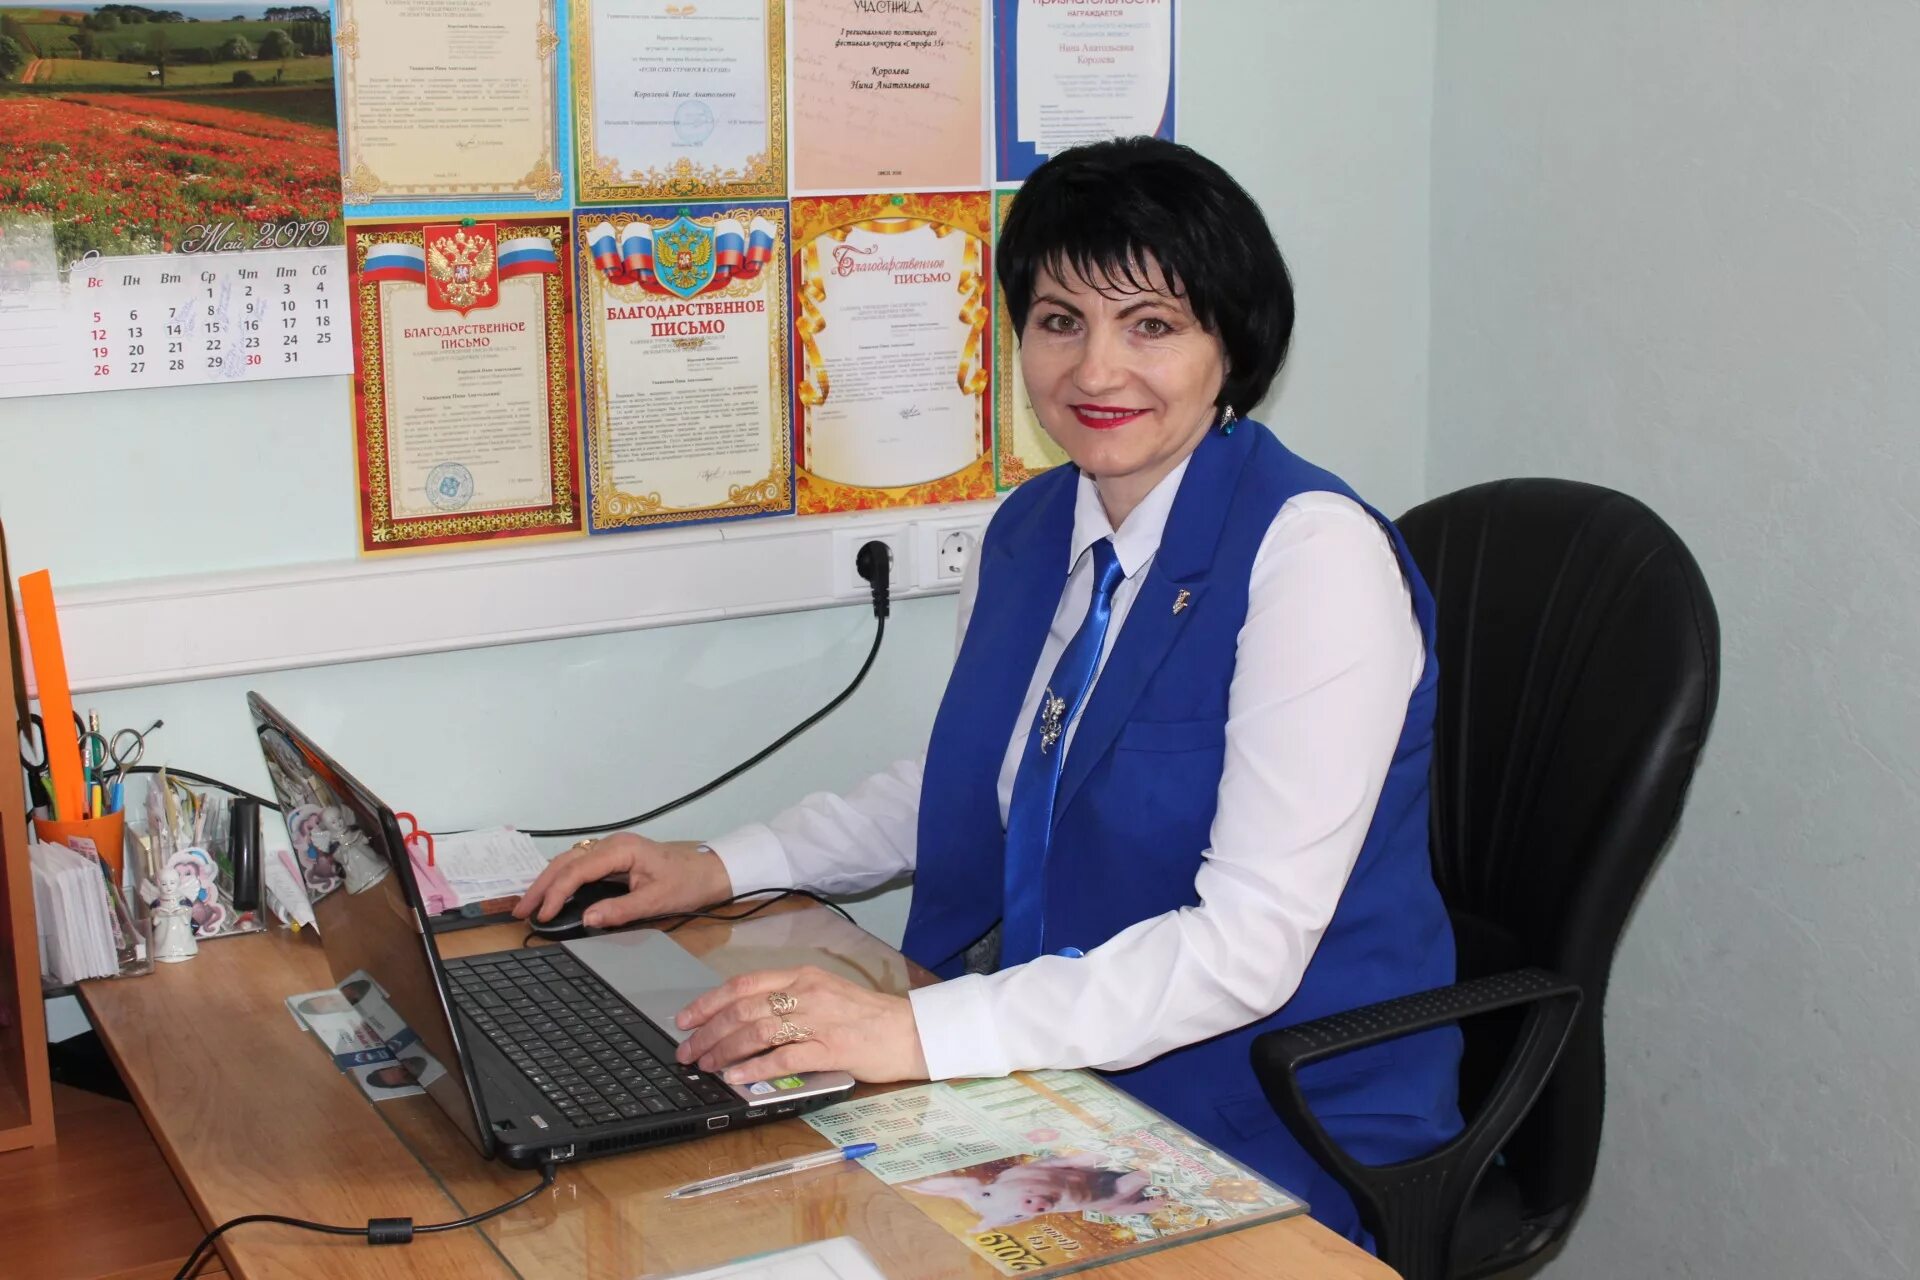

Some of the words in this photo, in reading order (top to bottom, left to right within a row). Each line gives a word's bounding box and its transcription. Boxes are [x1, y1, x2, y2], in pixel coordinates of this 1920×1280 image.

[853, 0, 923, 13] УЧАСТНИКА
[871, 66, 910, 77] Королева
[850, 81, 874, 90] Нина
[253, 220, 330, 248] 2019
[831, 244, 945, 277] Благодарственное
[87, 277, 103, 288] Вс
[122, 274, 141, 286] Пн
[160, 272, 181, 284] Вт
[201, 270, 216, 284] Ср
[238, 268, 258, 279] Чт
[276, 266, 297, 278] Пт
[312, 264, 327, 276] Сб
[894, 272, 951, 284] ПИСЬМО
[207, 288, 213, 298] 1
[245, 285, 252, 296] 2
[283, 283, 291, 294] 3
[316, 281, 324, 292] 4
[93, 311, 101, 323] 5
[130, 309, 138, 320] 6
[169, 307, 176, 318] 7
[207, 305, 215, 316] 8
[246, 303, 254, 314] 9
[281, 300, 296, 311] 10
[315, 298, 328, 309] 11
[607, 300, 765, 320] БЛАГОДАРСТВЕННОЕ
[91, 329, 107, 340] 12
[128, 327, 143, 338] 13
[166, 324, 182, 336] 14
[205, 322, 220, 333] 15
[244, 320, 259, 331] 16
[282, 317, 297, 329] 17
[316, 315, 330, 326] 18
[404, 321, 526, 338] БЛАГОДАРСТВЕННОЕ
[651, 319, 725, 337] ПИСЬМО
[92, 347, 108, 358] 19
[128, 344, 144, 356] 20
[168, 342, 183, 353] 21
[206, 340, 221, 351] 22
[245, 337, 260, 348] 23
[283, 335, 298, 346] 24
[316, 332, 331, 344] 25
[441, 337, 490, 349] ПИСЬМО
[94, 364, 110, 376] 26
[130, 361, 145, 373] 27
[169, 359, 184, 371] 28
[207, 356, 223, 368] 29
[246, 354, 262, 366] 30
[284, 351, 298, 363] 31
[976, 1231, 1044, 1271] 2019
